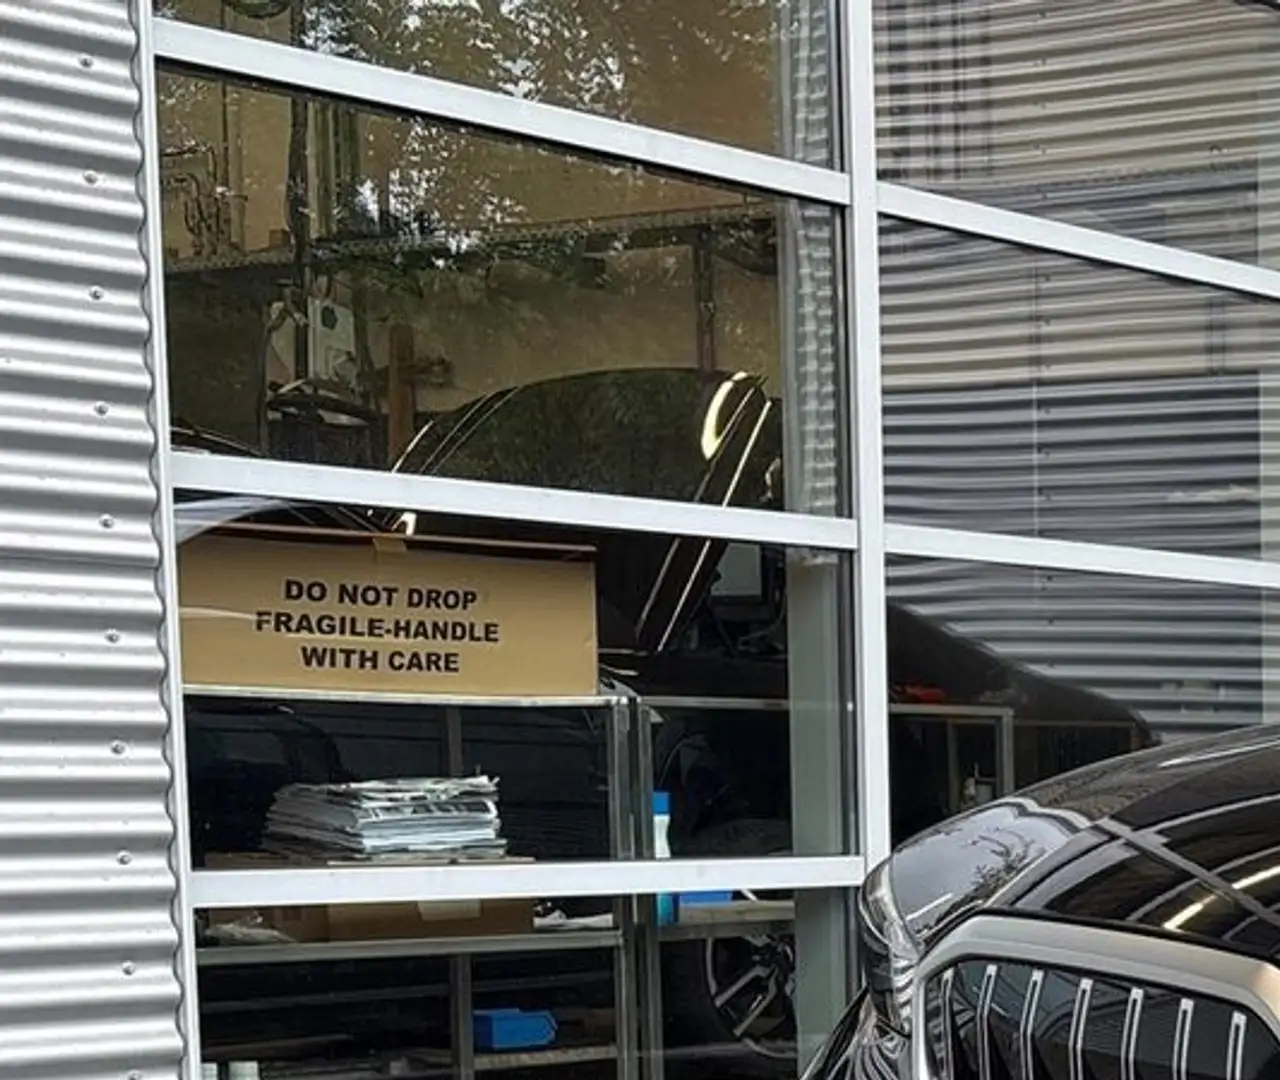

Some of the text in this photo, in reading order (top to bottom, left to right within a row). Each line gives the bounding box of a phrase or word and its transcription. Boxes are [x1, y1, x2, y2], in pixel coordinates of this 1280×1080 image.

[285, 579, 477, 611] DO NOT DROP
[256, 611, 500, 642] FRAGILE-HANDLE
[301, 646, 460, 673] WITH CARE
